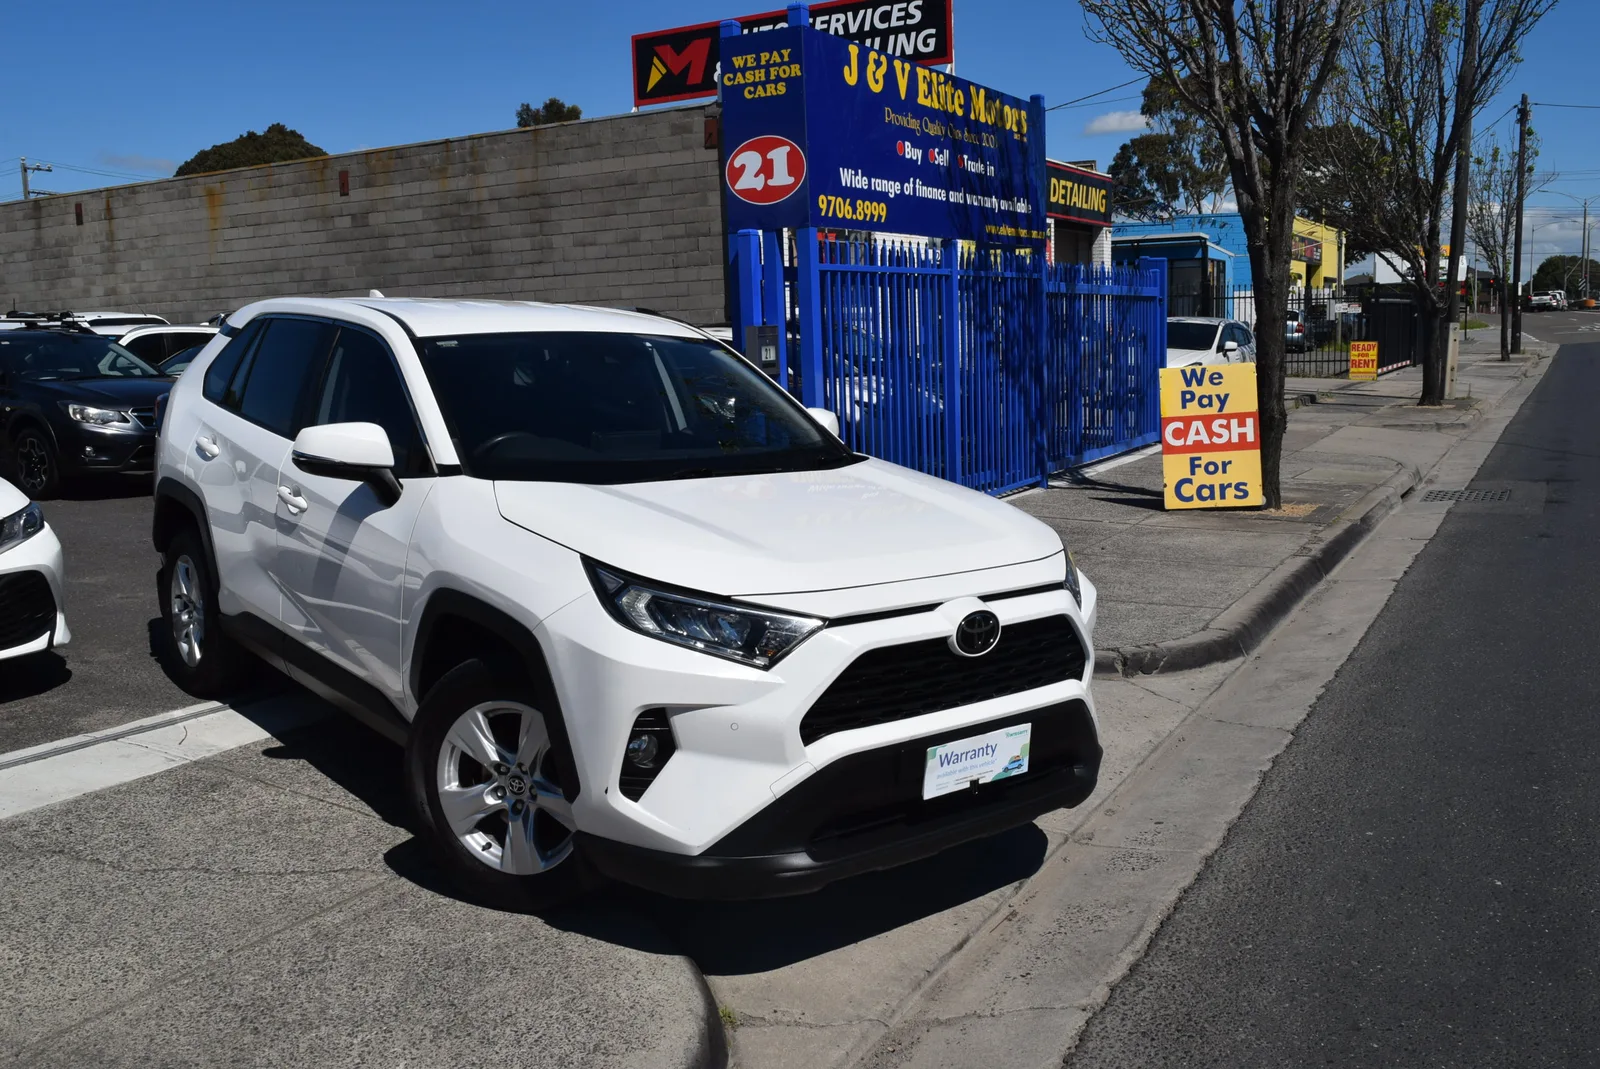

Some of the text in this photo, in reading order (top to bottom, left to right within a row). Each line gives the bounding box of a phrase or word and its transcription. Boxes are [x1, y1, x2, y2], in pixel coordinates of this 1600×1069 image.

[809, 0, 923, 36] ERVICES
[732, 49, 791, 69] WE PAY
[723, 69, 766, 86] CASH
[769, 63, 801, 81] FOR
[744, 82, 787, 100] CARS
[843, 44, 1027, 134] J & V Elite Motors
[884, 107, 921, 136] Providing
[922, 117, 945, 141] Quality
[733, 145, 795, 191] 21
[904, 141, 995, 177] Buy Sell Trade in
[839, 167, 1032, 213] Wide range of finance and warranty available
[1049, 177, 1107, 213] DETAILING
[817, 194, 887, 223] 9706.8999
[764, 347, 772, 360] 21
[1351, 343, 1377, 352] READY
[1351, 358, 1376, 369] RENT
[1180, 367, 1224, 388] We
[1180, 390, 1230, 413] Pay
[1164, 417, 1255, 447] CASH
[1189, 456, 1233, 476] For
[1174, 477, 1250, 503] Cars
[939, 742, 998, 768] Warranty
